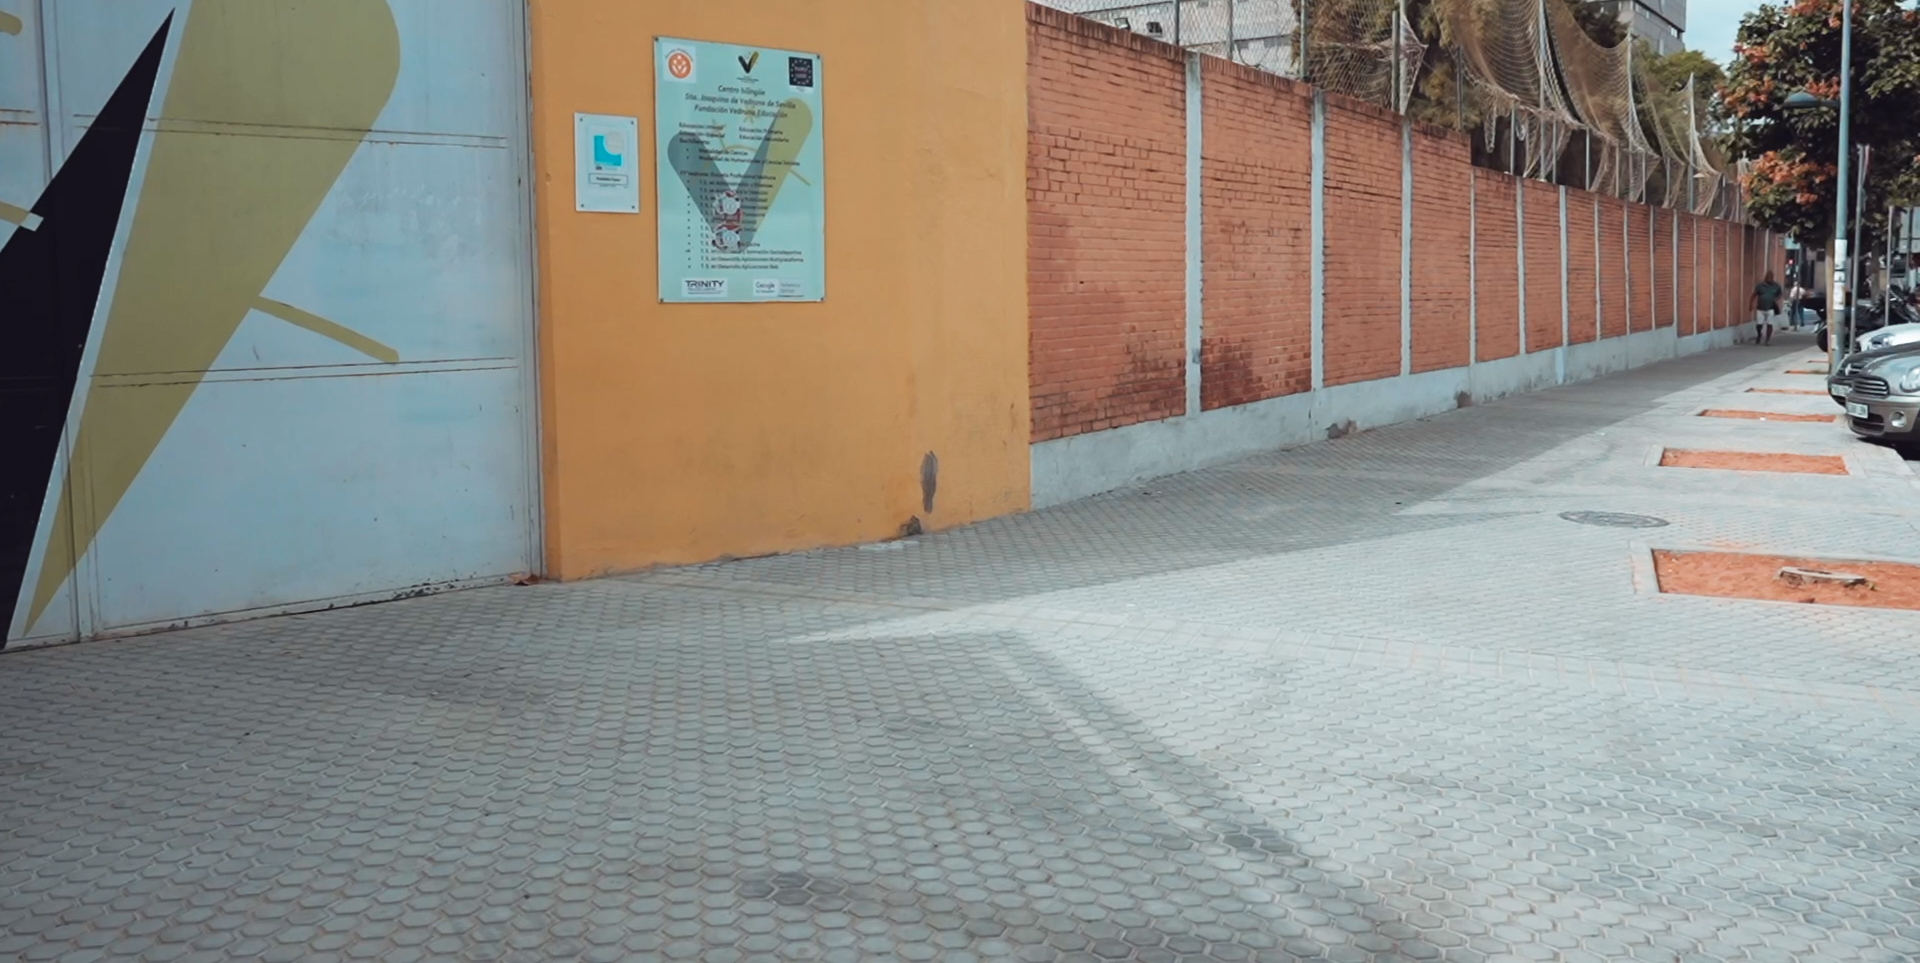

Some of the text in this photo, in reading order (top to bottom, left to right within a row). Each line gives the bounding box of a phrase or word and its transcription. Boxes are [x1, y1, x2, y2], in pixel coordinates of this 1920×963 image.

[718, 85, 766, 97] Centro bilingüe
[685, 92, 699, 101] Sta.
[767, 99, 774, 107] de
[776, 101, 796, 109] Sevilla
[694, 104, 728, 114] Fundación
[729, 107, 756, 116] Vedruna
[685, 280, 725, 288] TRINITY
[755, 281, 775, 290] Google
